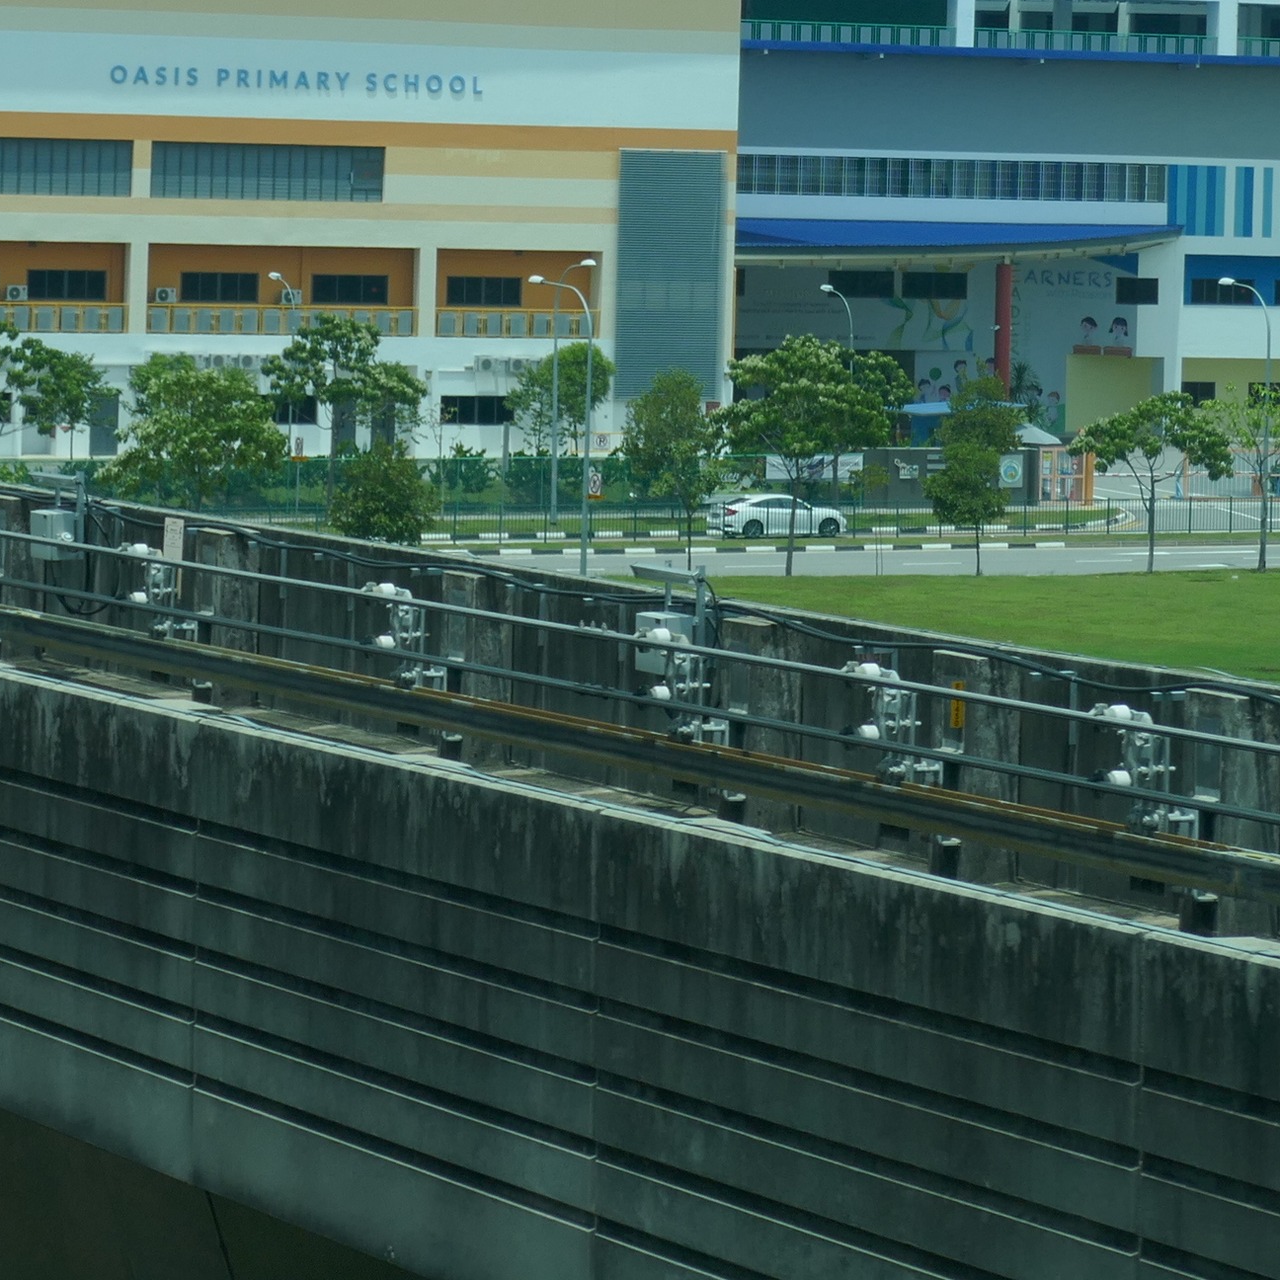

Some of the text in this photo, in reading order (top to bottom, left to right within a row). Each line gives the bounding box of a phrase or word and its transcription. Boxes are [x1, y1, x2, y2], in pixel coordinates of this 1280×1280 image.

[110, 65, 484, 95] OASIS PRIMARY SCHOOL
